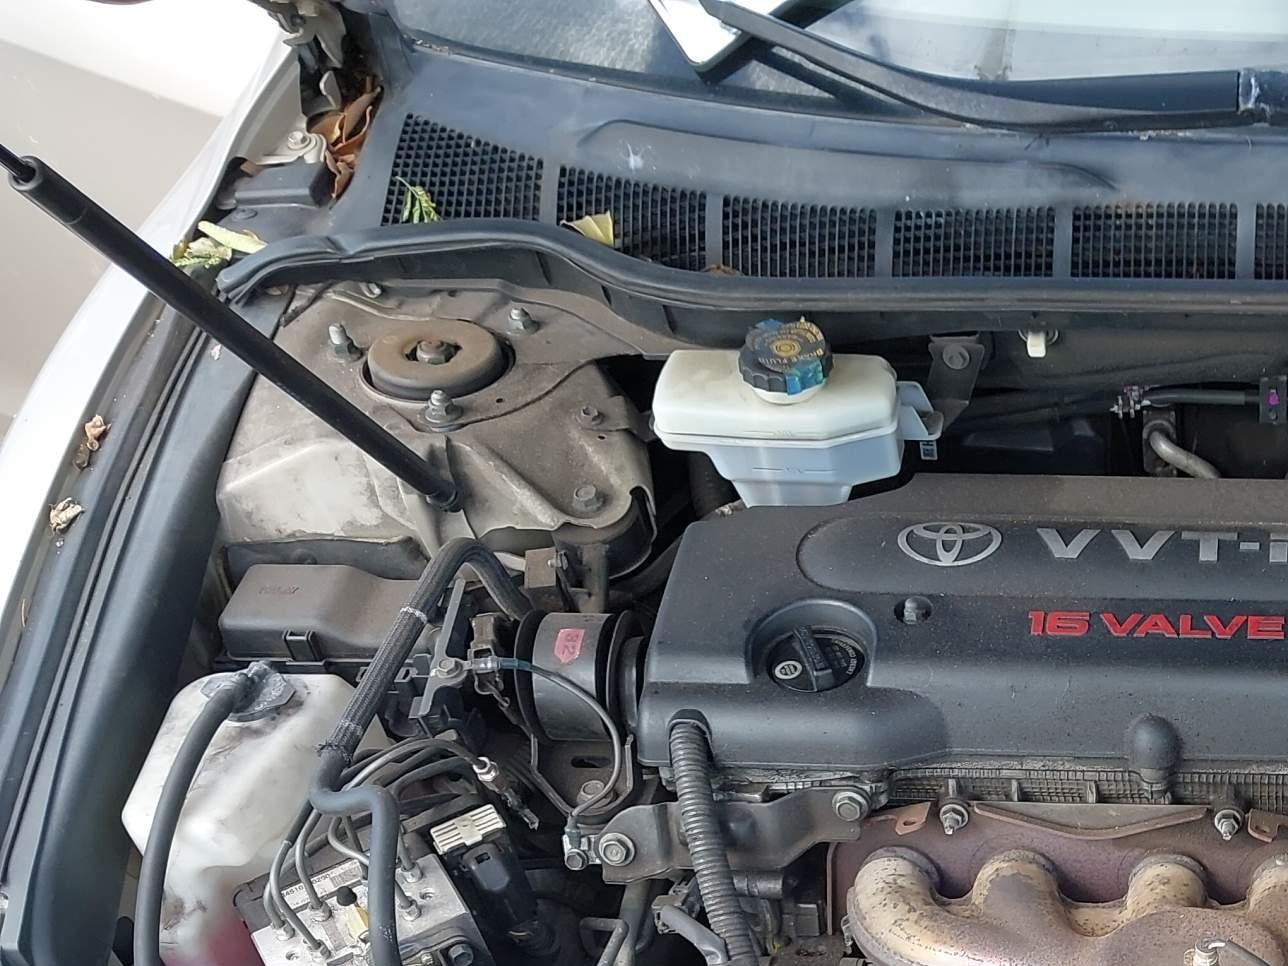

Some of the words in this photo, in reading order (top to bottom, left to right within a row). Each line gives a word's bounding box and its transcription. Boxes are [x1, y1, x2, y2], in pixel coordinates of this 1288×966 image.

[1036, 528, 1288, 563] VVT-i
[1028, 611, 1091, 636] 16
[1100, 612, 1285, 639] VALVE
